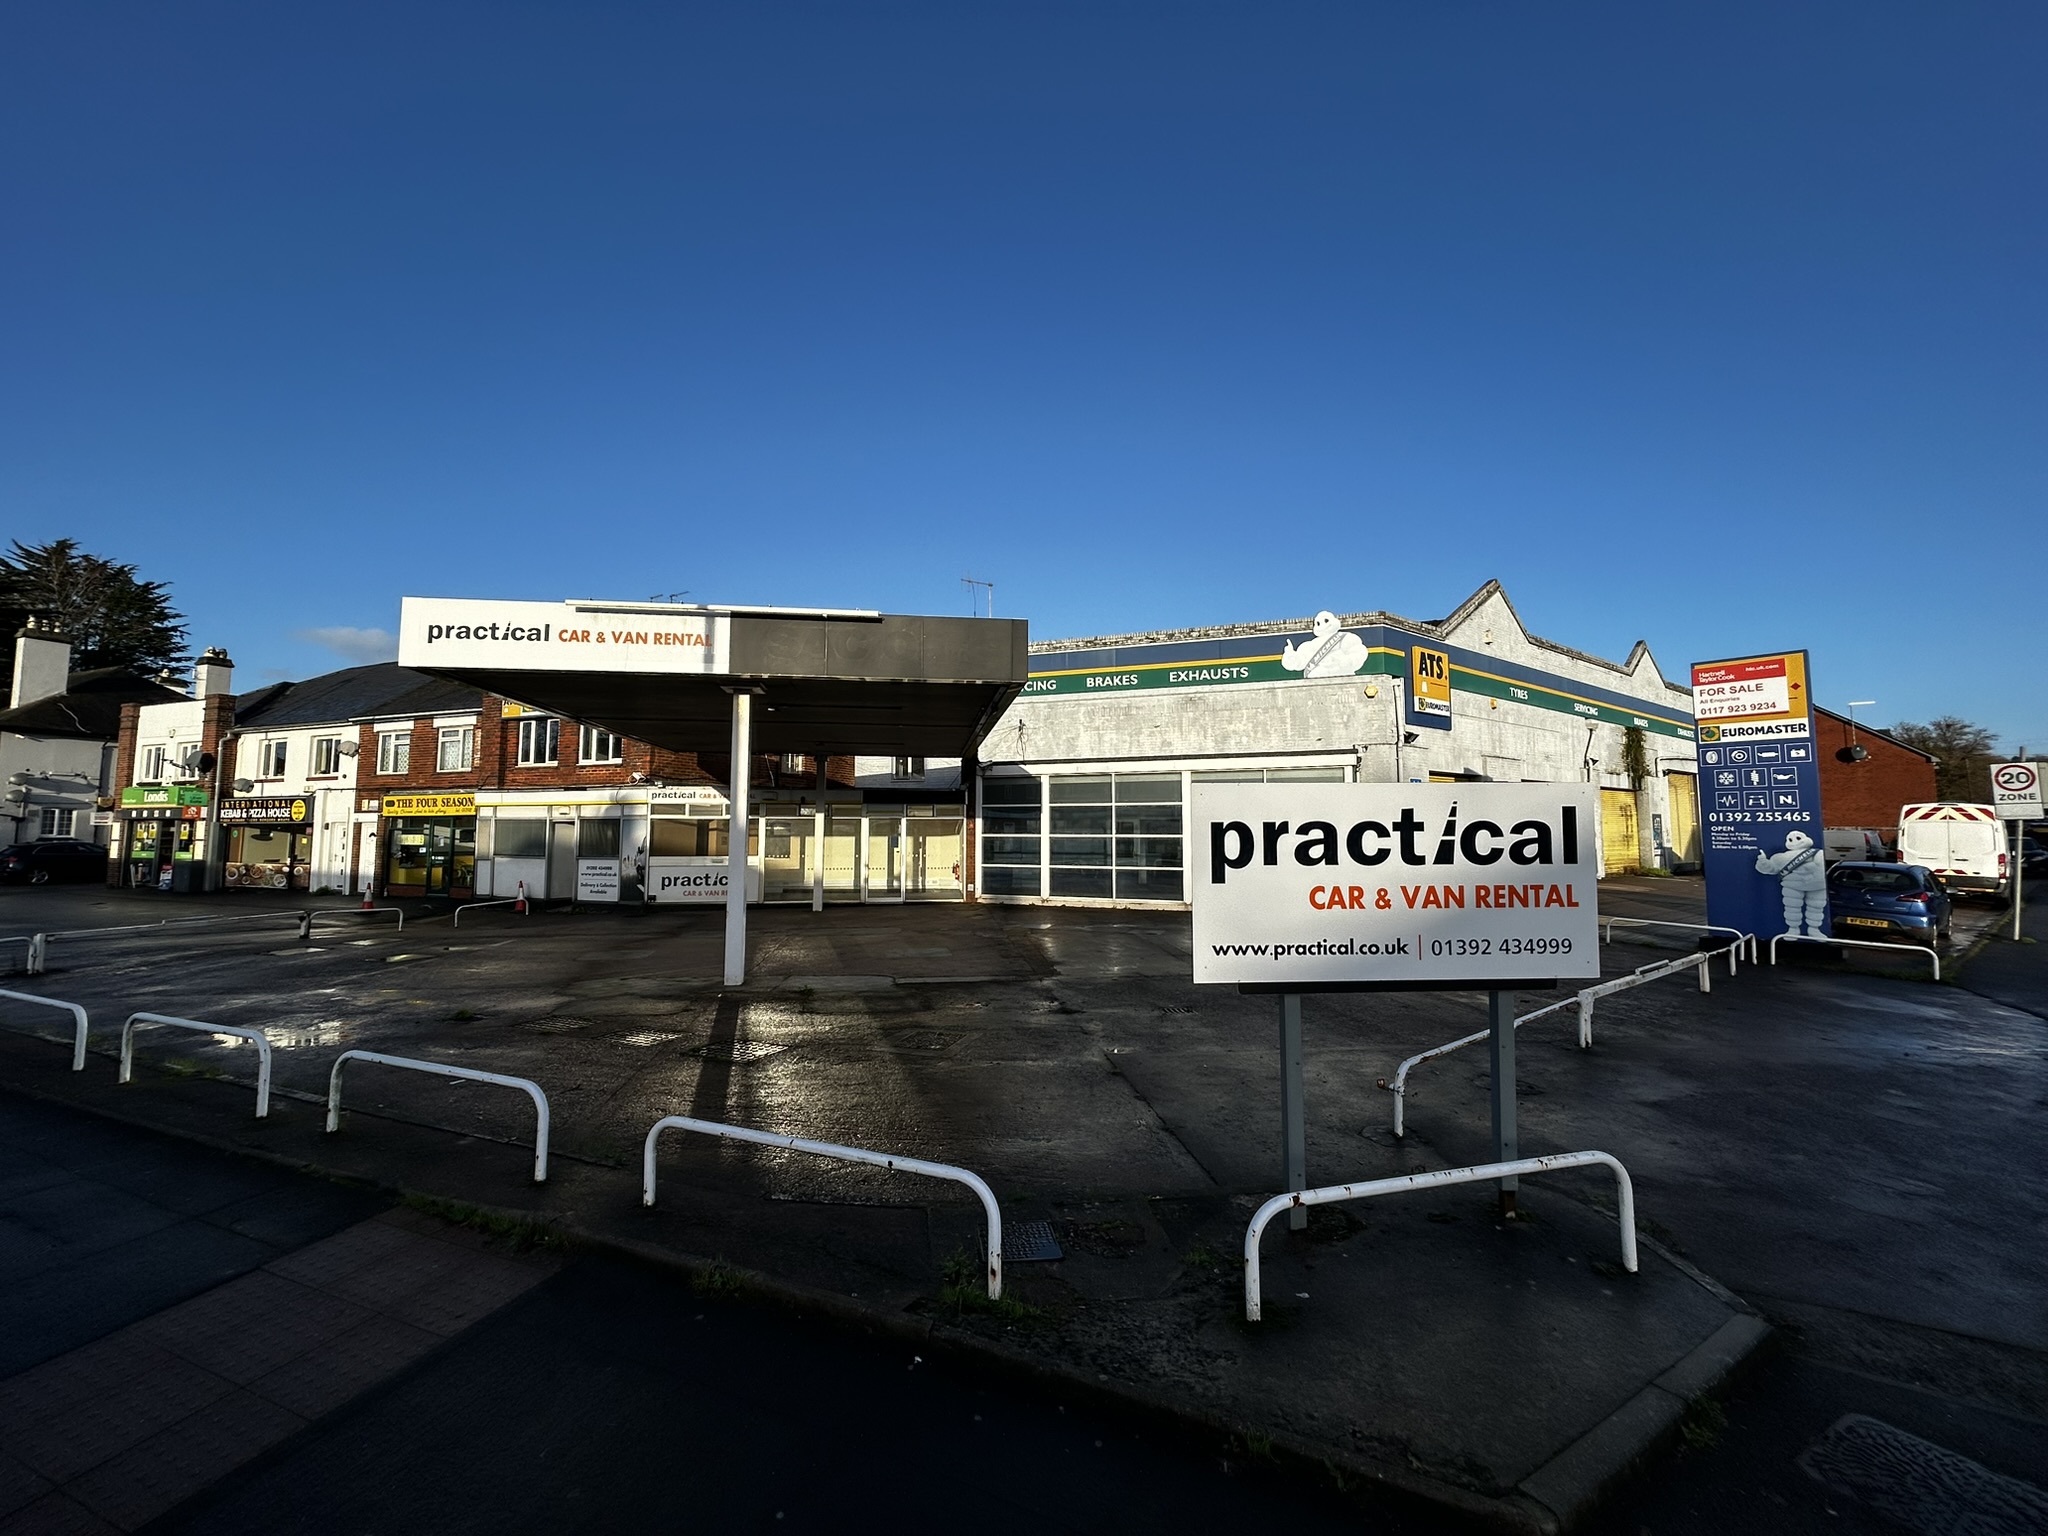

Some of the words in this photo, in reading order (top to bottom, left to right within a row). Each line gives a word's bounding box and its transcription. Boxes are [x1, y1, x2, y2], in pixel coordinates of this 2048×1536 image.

[428, 621, 550, 643] practical
[558, 630, 590, 643] CAR
[596, 632, 606, 643] &
[611, 631, 648, 645] VAN
[654, 633, 712, 647] RENTAL
[1418, 651, 1444, 680] ATS
[1021, 679, 1057, 692] CING
[1086, 674, 1138, 688] BRAKES
[1169, 667, 1249, 682] EXHAUSTS
[1509, 687, 1529, 700] TYRES
[1699, 687, 1726, 697] FOR
[1729, 683, 1764, 694] SALE
[1709, 696, 1740, 704] Enquiries
[1700, 706, 1724, 715] 0117
[1727, 704, 1747, 713] 923
[1750, 701, 1777, 711] 9234
[1721, 723, 1808, 738] EUROMASTER
[2001, 772, 2030, 784] 20
[144, 790, 169, 803] Londis
[652, 791, 696, 800] practical
[220, 800, 291, 808] INTERNATIONAL
[396, 799, 413, 808] THE
[416, 798, 438, 808] FOUR
[220, 809, 242, 818] KEBAB
[242, 808, 247, 818] &
[248, 808, 267, 818] PIZZA
[267, 808, 291, 818] HOUSE
[1709, 812, 1752, 822] 01392
[1756, 812, 1811, 822] 255465
[1211, 801, 1578, 884] practical
[661, 872, 729, 890] practic
[1309, 886, 1365, 909] CAR
[1375, 888, 1391, 910] &
[1400, 886, 1464, 909] VAN
[1476, 884, 1579, 909] RENTAL
[1212, 937, 1409, 960] www.practical.co.uk
[1431, 939, 1491, 956] 01392
[1499, 938, 1573, 956] 434999
